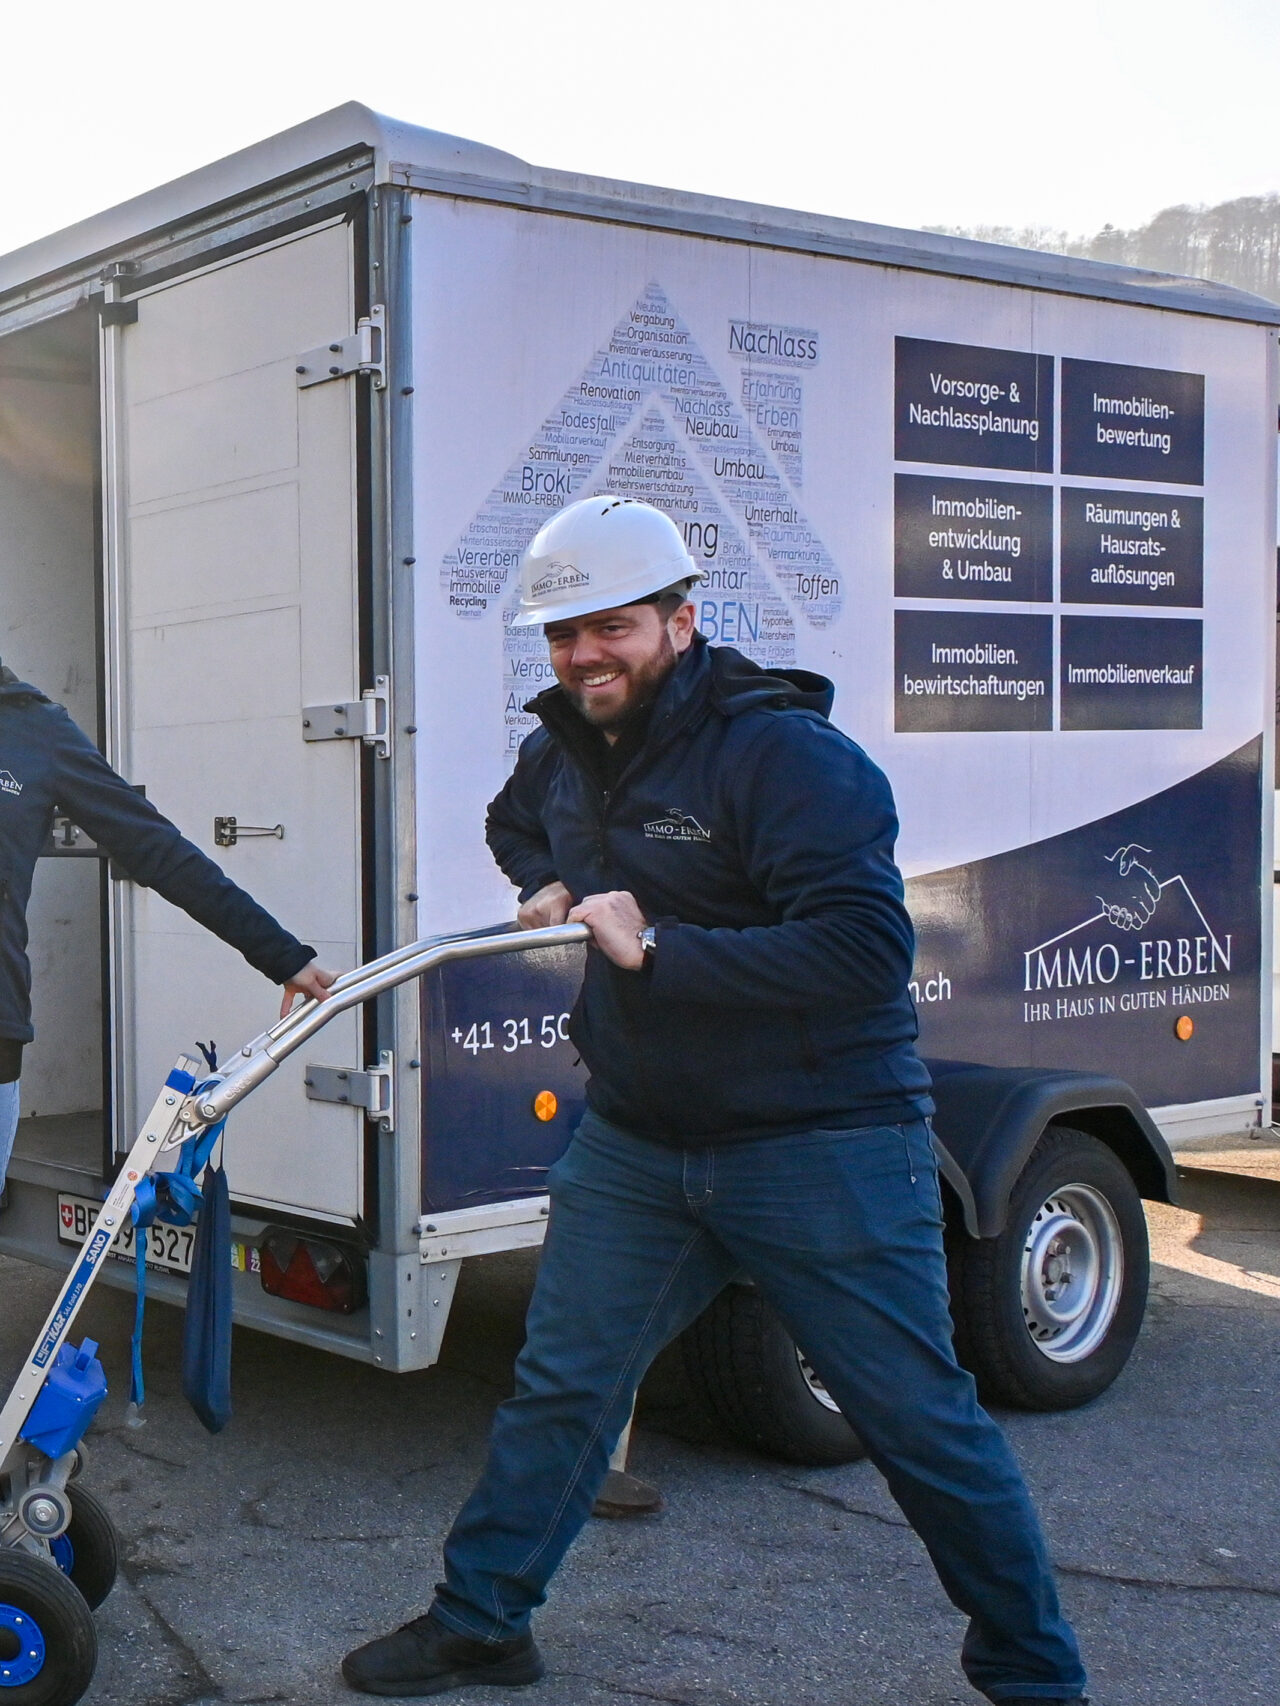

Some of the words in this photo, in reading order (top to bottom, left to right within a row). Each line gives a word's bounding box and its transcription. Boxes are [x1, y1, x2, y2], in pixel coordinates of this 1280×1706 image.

[630, 312, 675, 329] Vergabung
[627, 327, 688, 344] Organisation
[729, 325, 817, 360] Nachlass
[609, 343, 692, 364] Inventarveräusserung
[600, 357, 696, 386] Antiquitäten
[580, 382, 641, 401] Renovation
[742, 378, 801, 404] Erfahrung
[930, 373, 1006, 402] Vorsorge-
[1009, 382, 1021, 403] &
[675, 397, 730, 417] Nachlass
[757, 405, 798, 428] Erben
[1093, 393, 1175, 420] Immobilien-
[561, 411, 616, 434] Todesfall
[686, 416, 739, 439] Neubau
[909, 403, 1039, 441] Nachlassplanung
[632, 438, 675, 453] Entsorgung
[771, 440, 800, 453] Umbau
[1097, 423, 1171, 453] bewertung
[529, 447, 590, 465] Sammlungen
[624, 452, 686, 467] Mietverhältnis
[609, 465, 684, 480] Immobilienumbau
[714, 457, 765, 479] Umbau
[522, 466, 571, 494] Broki
[503, 491, 565, 507] IMMO-ERBEN
[932, 495, 1022, 520] Immobilien-
[745, 505, 798, 524] Unterhalt
[1085, 503, 1168, 532] Räumungen
[1171, 510, 1181, 529] &
[929, 529, 1021, 557] entwicklung
[1100, 535, 1166, 557] Hausrats-
[458, 547, 519, 567] Vererben
[768, 548, 820, 564] Vermarktung
[451, 567, 508, 583] Hausverkauf
[531, 572, 590, 593] IMMO-ERBEN
[942, 560, 953, 580] &
[957, 561, 1012, 583] Umbau
[1091, 564, 1175, 591] auflösungen
[450, 580, 501, 594] Immobilie
[796, 573, 839, 600] Toffen
[450, 595, 487, 609] Recycling
[504, 625, 540, 638] Todesfall
[762, 616, 793, 630] Hypothek
[759, 630, 795, 642] Altersheim
[931, 642, 1019, 665] Immobilien.
[1068, 664, 1194, 686] Immobilienverkauf
[904, 675, 1045, 700] bewirtschaftungen
[1024, 934, 1232, 992] IMMO-ERBEN
[1024, 1002, 1050, 1022] IHR
[1057, 997, 1094, 1019] HAUS
[1100, 994, 1116, 1014] IN
[1120, 989, 1167, 1012] GUTEN
[1172, 983, 1230, 1007] HÄNDEN
[451, 1022, 495, 1055] +41
[503, 1017, 533, 1052] 31
[86, 1234, 106, 1264] SANO
[152, 1224, 194, 1266] 527
